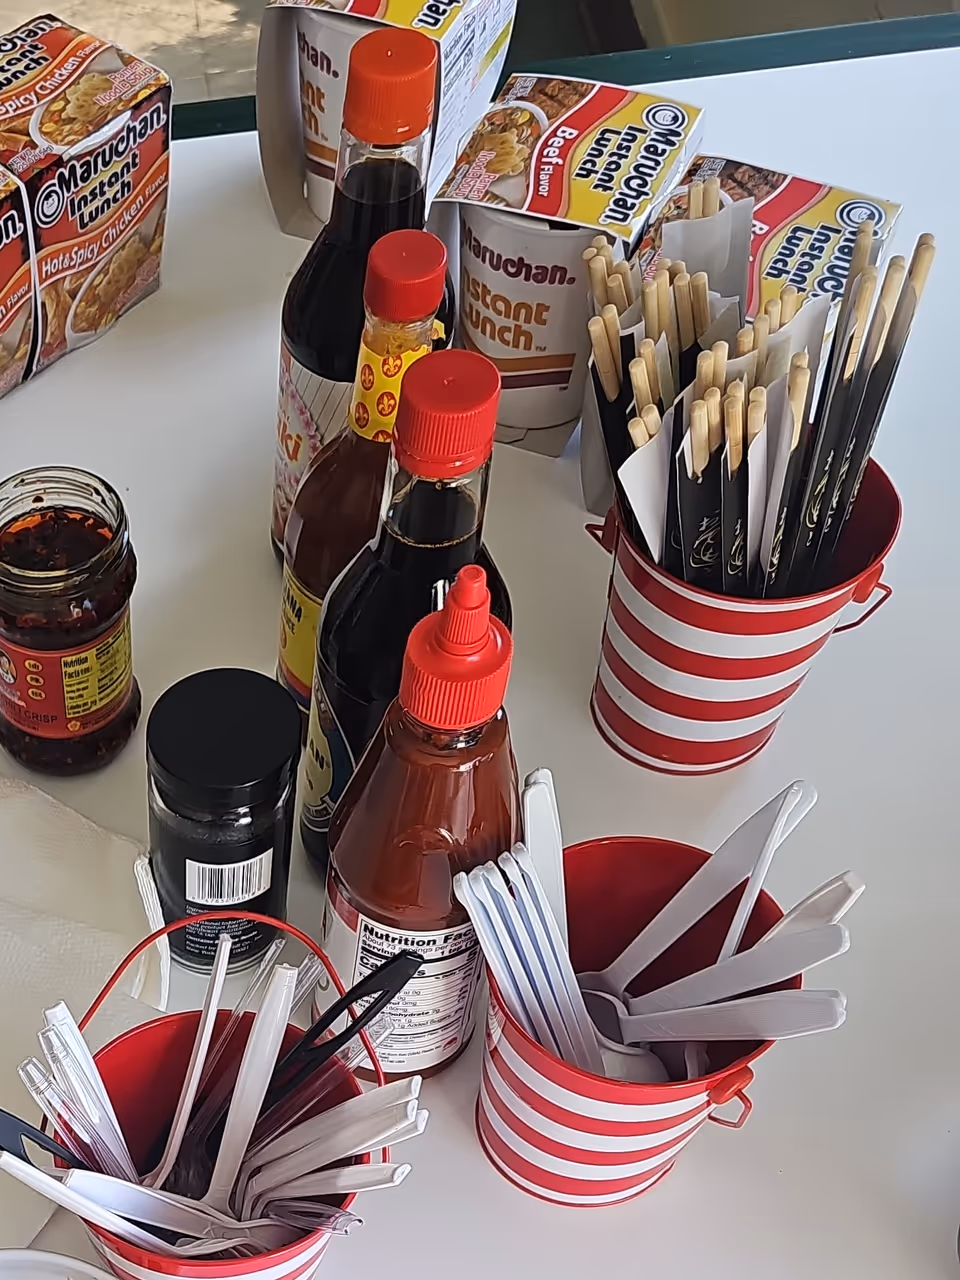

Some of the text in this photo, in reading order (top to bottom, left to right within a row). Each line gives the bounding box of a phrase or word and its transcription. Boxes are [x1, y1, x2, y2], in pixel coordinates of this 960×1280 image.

[37, 57, 80, 95] Chicken
[77, 40, 100, 59] Flavor
[95, 67, 153, 105] Noodle Soup
[108, 61, 143, 82] Ramen
[455, 151, 495, 197] Noodle Soup
[537, 126, 579, 196] Beef Flavor
[574, 129, 622, 179] Lunch
[594, 126, 648, 192] Instant
[69, 152, 138, 215] Instant
[79, 180, 132, 229] Lunch
[475, 173, 498, 199] Ramen
[101, 195, 144, 246] Chicken
[146, 171, 167, 197] Flavor
[765, 225, 814, 279] Lunch
[789, 224, 840, 293] Instant
[7, 282, 29, 307] Flavor
[63, 656, 88, 668] Nutrition
[24, 710, 58, 723] CRISP
[362, 934, 384, 947] About
[398, 946, 433, 954] servings
[435, 944, 448, 952] per
[362, 940, 397, 956] Serving
[363, 924, 475, 947] Nutrition Fac
